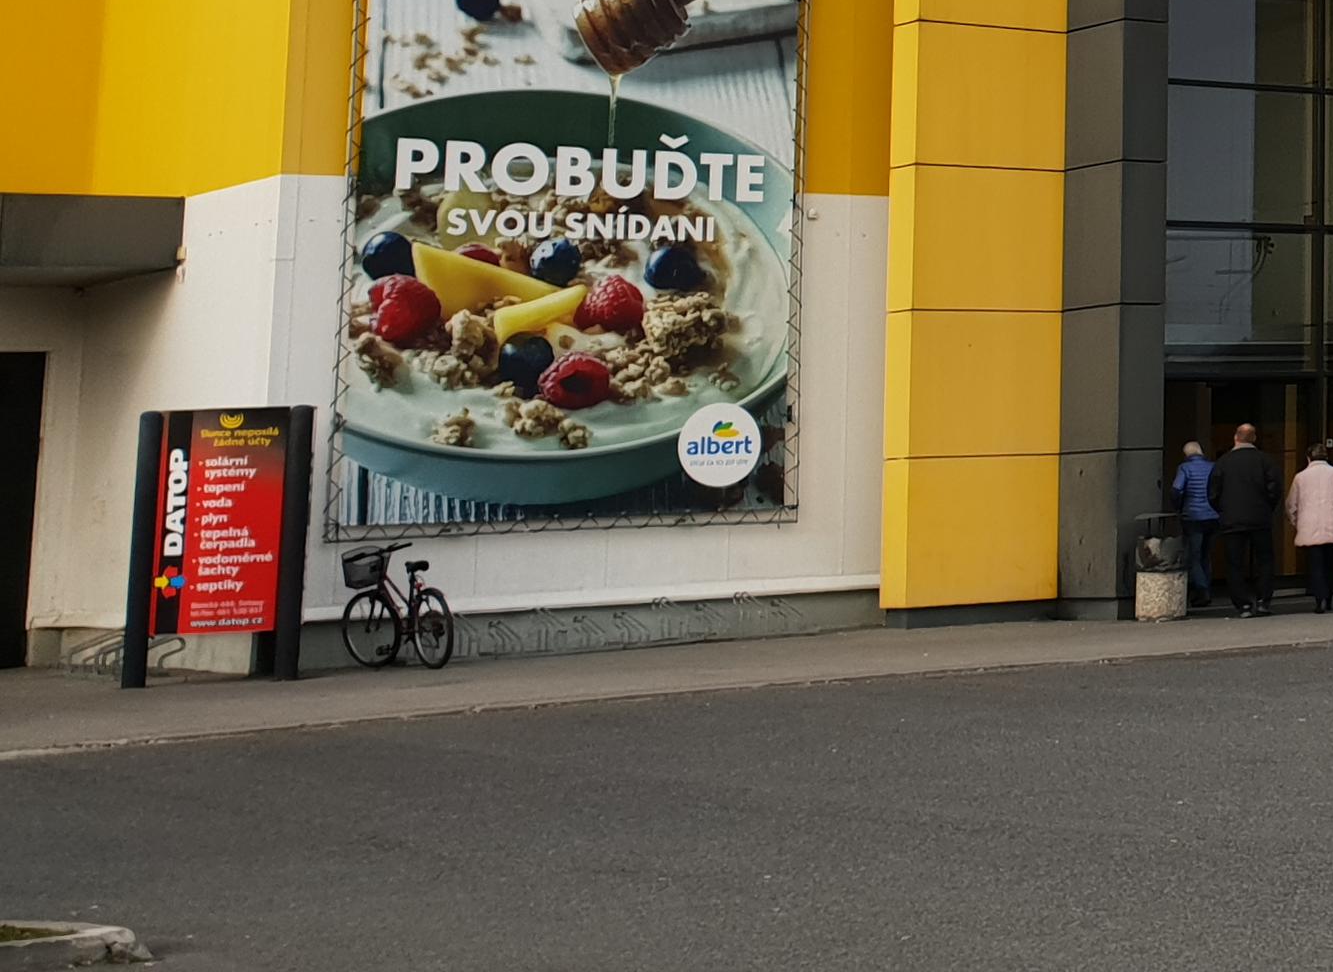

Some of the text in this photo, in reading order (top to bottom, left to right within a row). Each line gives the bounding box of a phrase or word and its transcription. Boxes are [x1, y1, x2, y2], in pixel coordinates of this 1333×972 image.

[394, 134, 765, 203] PROBUĎTE
[446, 206, 714, 242] SVOU SNÍDANI
[686, 435, 752, 455] albert
[205, 455, 249, 467] solární
[205, 466, 257, 480] systémy
[203, 481, 246, 496] topení
[163, 448, 188, 556] DATOP
[202, 497, 233, 508] voda
[201, 513, 228, 526] plyn
[200, 526, 249, 540] tepelná
[199, 537, 256, 551] čerpadla
[197, 552, 273, 564] vodoměrné
